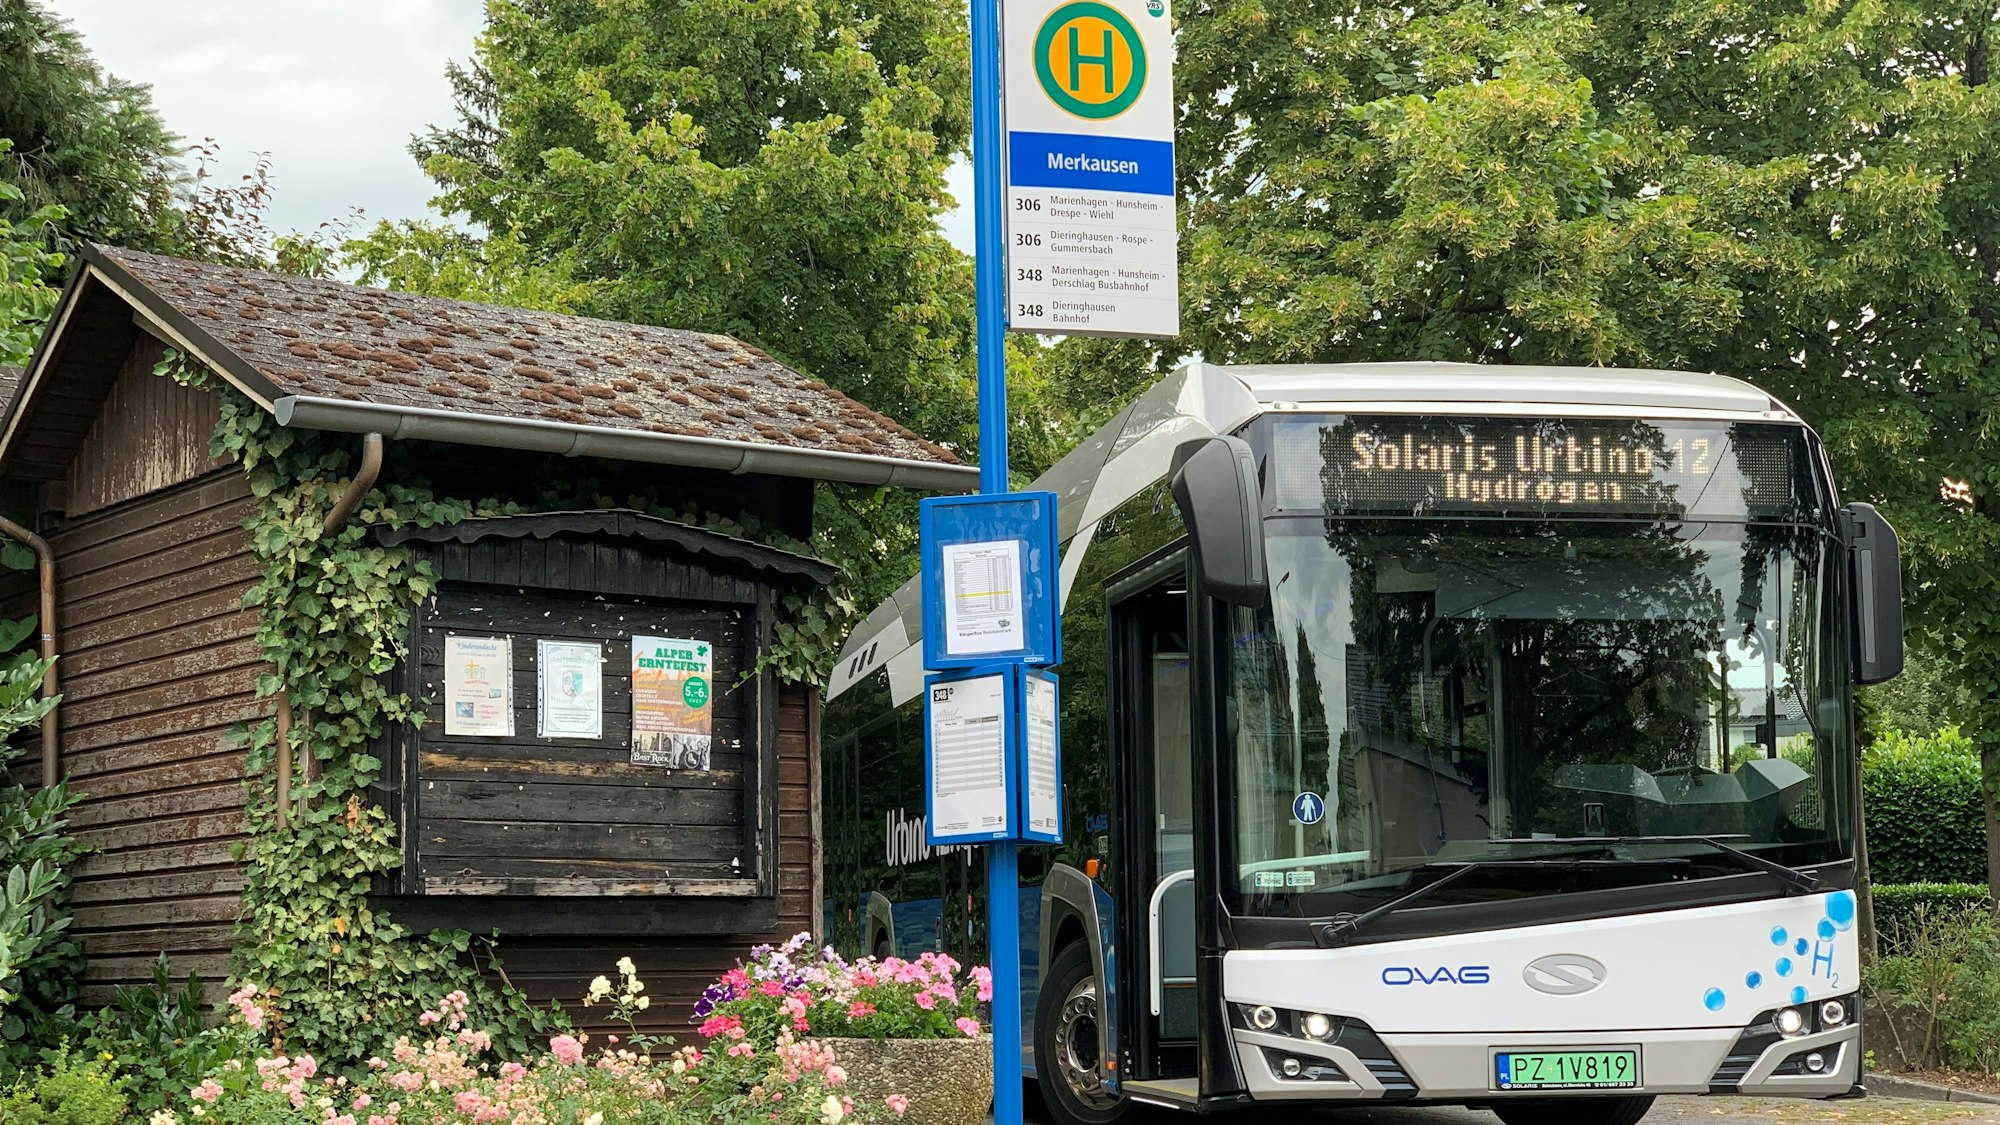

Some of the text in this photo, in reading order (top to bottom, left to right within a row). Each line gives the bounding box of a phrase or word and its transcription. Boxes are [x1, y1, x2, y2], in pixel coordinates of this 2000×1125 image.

[1146, 1, 1160, 9] VRS
[1068, 27, 1114, 94] H
[1047, 152, 1139, 174] Merkausen
[1015, 198, 1041, 212] 306
[1050, 195, 1108, 208] Marienhagen
[1116, 199, 1158, 211] Hunsheim
[1050, 208, 1081, 219] Drespe
[1089, 209, 1114, 220] Wiehl
[1016, 233, 1041, 247] 306
[1050, 230, 1114, 244] Dieringhausen
[1122, 235, 1148, 246] Rospe
[1051, 243, 1113, 255] Gummersbach
[1017, 268, 1043, 282] 348
[1051, 265, 1110, 279] Marienhagen
[1118, 269, 1160, 280] Hunsheim
[1052, 278, 1149, 292] Derschlag Busbahnhof
[1018, 304, 1043, 317] 348
[1052, 301, 1116, 314] Dieringhausen
[1053, 313, 1090, 324] Bahnhof
[1351, 432, 1710, 475] Solaris Urbino 12
[1445, 472, 1622, 504] Hydrogen
[655, 648, 693, 660] ALPER
[638, 657, 707, 672] ERNTEFEST
[685, 686, 707, 698] 5.-6.
[934, 690, 947, 701] 348
[1382, 966, 1490, 985] OVAG
[1515, 1058, 1545, 1081] PZ
[1557, 1056, 1627, 1080] 1V819
